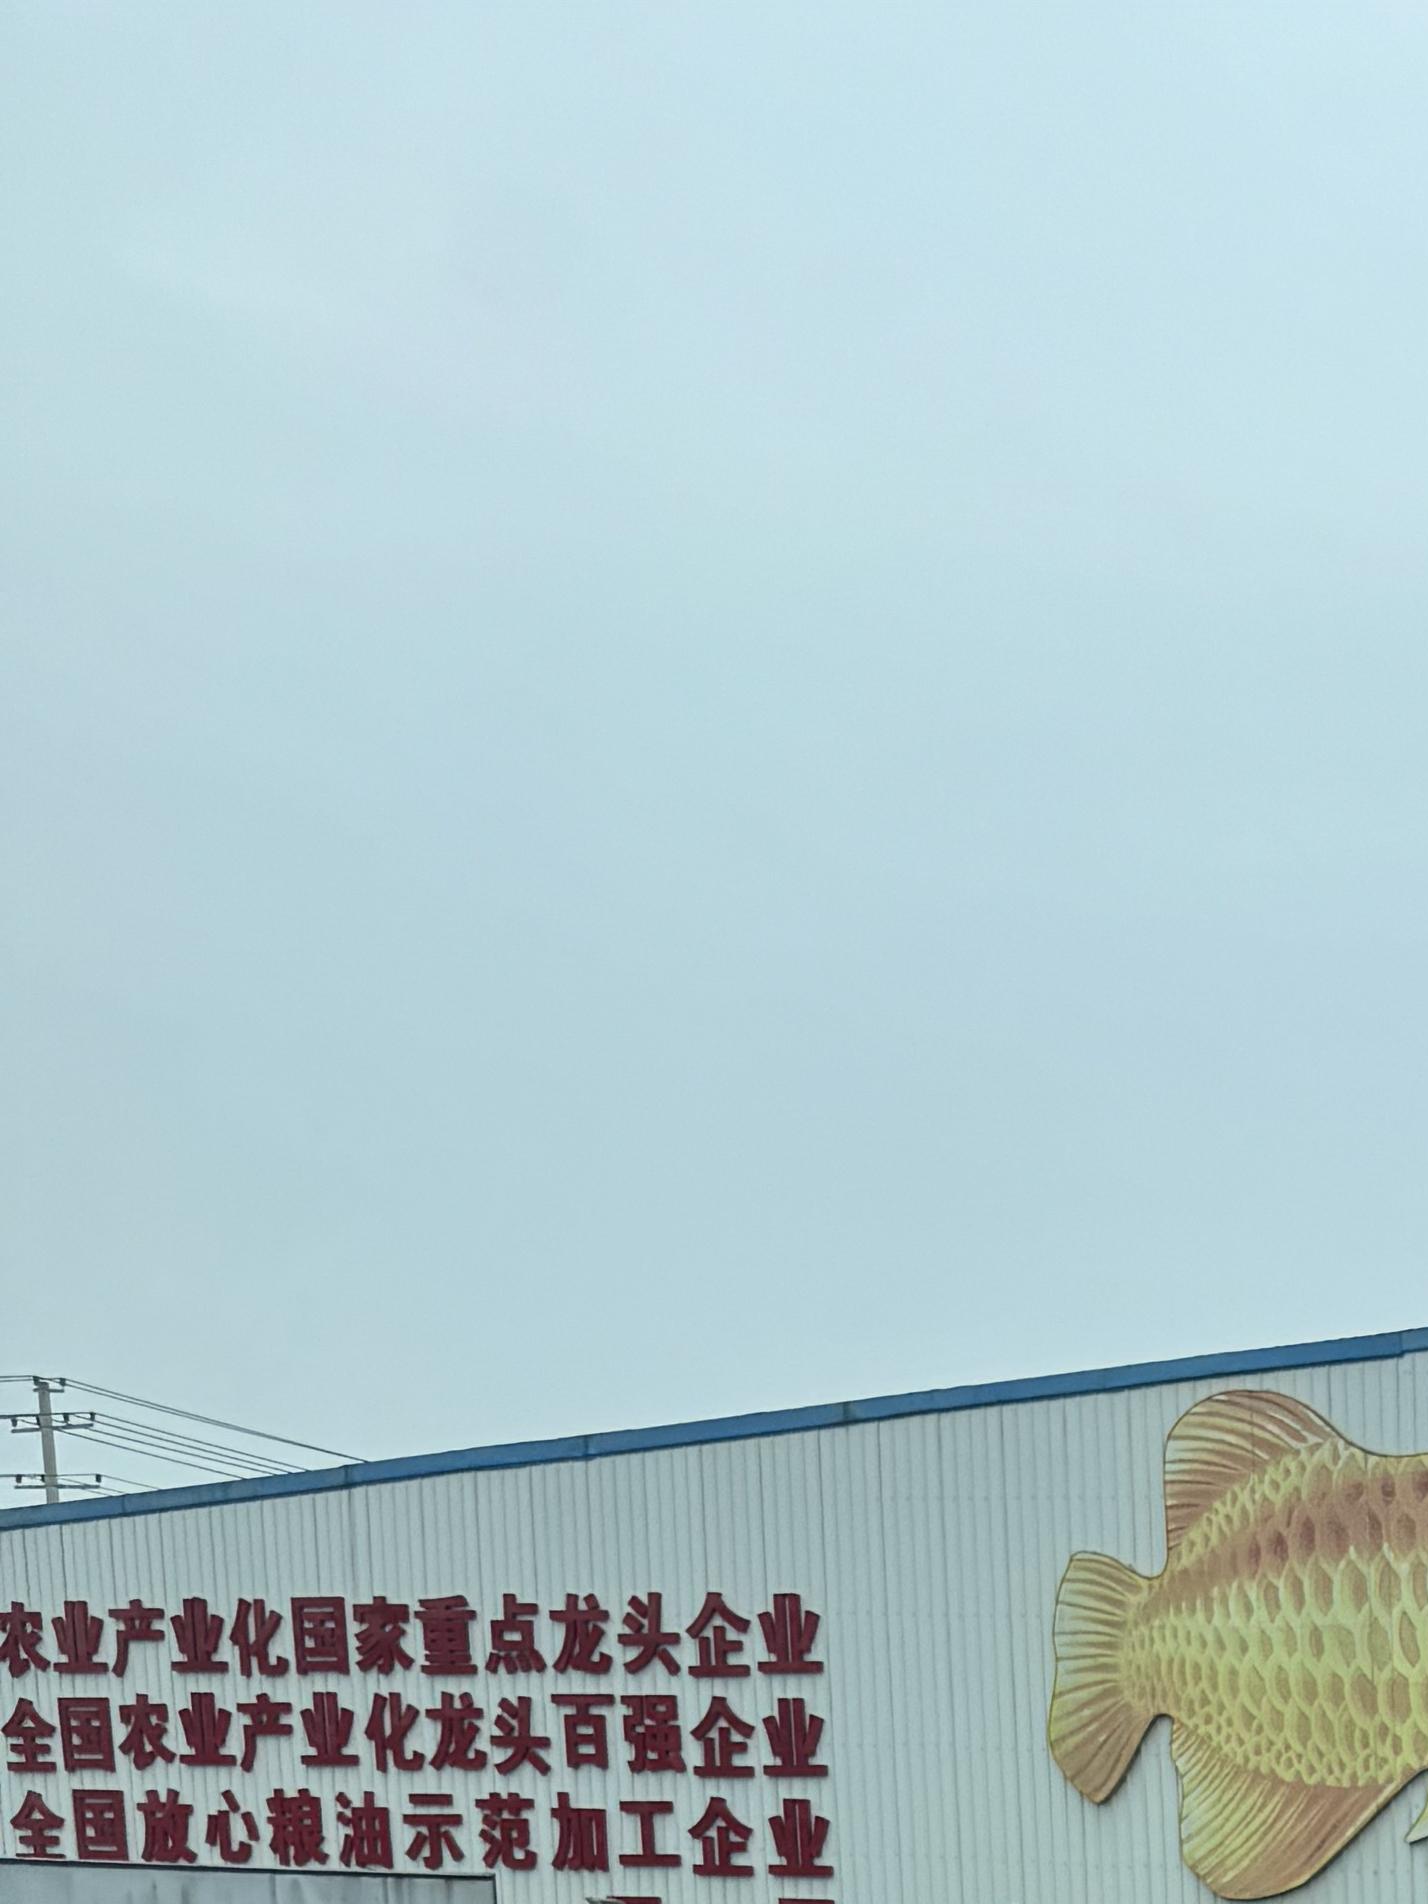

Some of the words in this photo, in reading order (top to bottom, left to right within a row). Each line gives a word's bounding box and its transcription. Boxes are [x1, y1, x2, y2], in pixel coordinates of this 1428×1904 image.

[0, 1593, 825, 1677] 农业产业化国家重点龙头企业
[5, 1690, 829, 1778] 全国农业产业化龙头百强企业
[9, 1788, 835, 1879] 全国放心粮油示范加工企业
